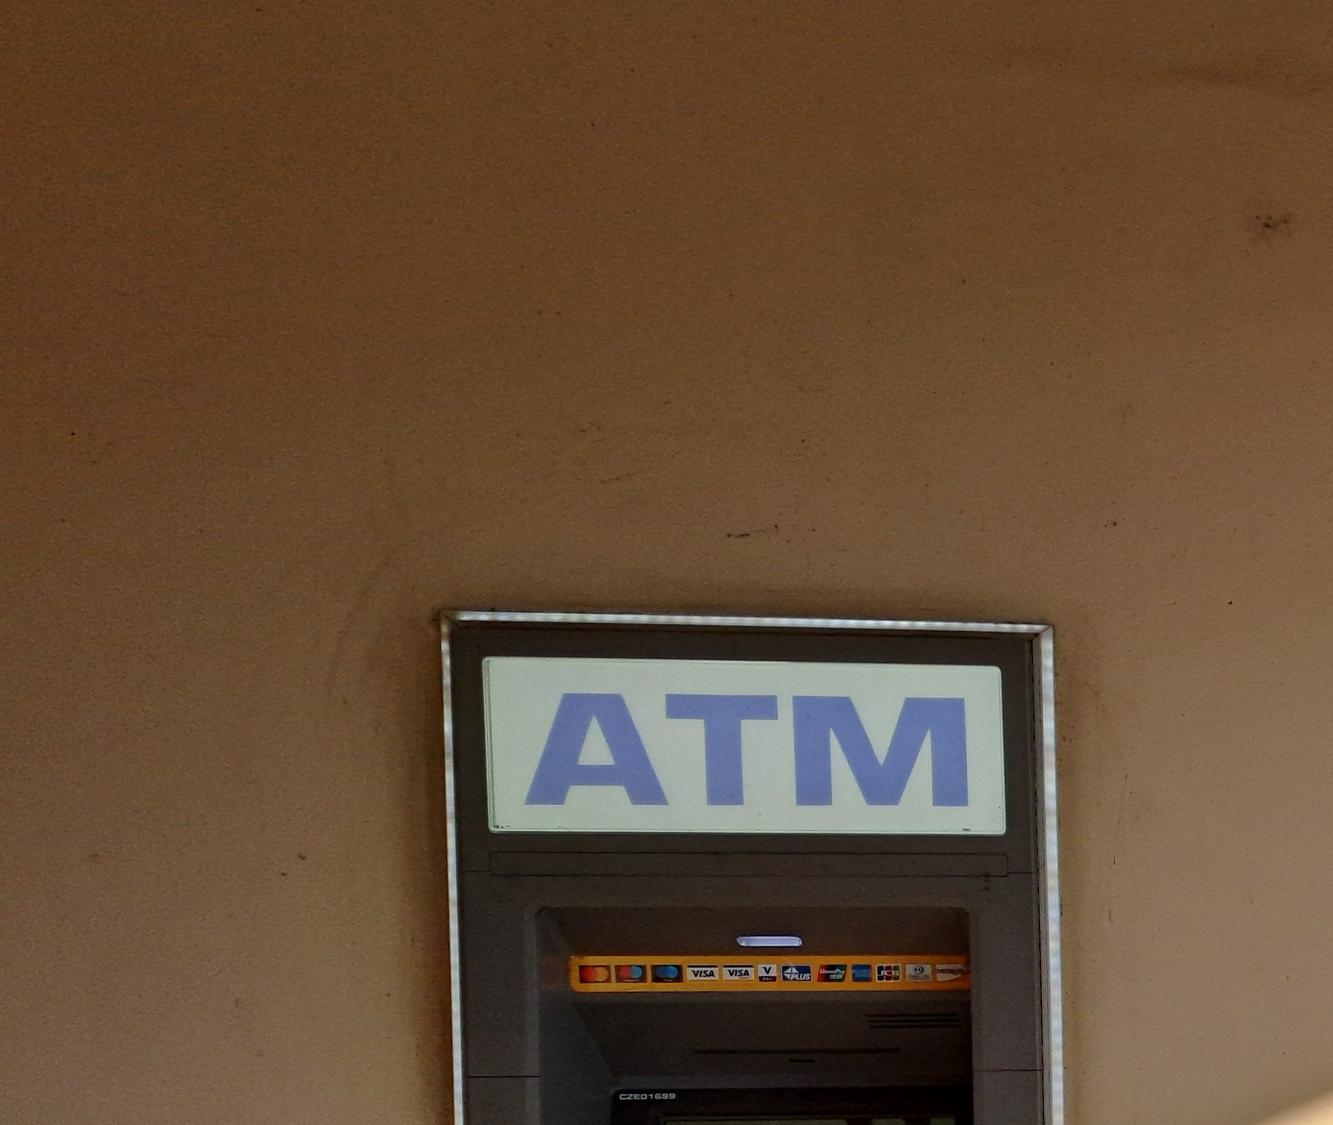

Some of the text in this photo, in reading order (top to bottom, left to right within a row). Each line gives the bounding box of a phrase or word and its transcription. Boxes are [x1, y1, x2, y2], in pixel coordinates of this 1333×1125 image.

[524, 692, 969, 807] ATM
[692, 969, 716, 978] VISA
[727, 968, 751, 977] VISA
[790, 972, 812, 982] PLUS
